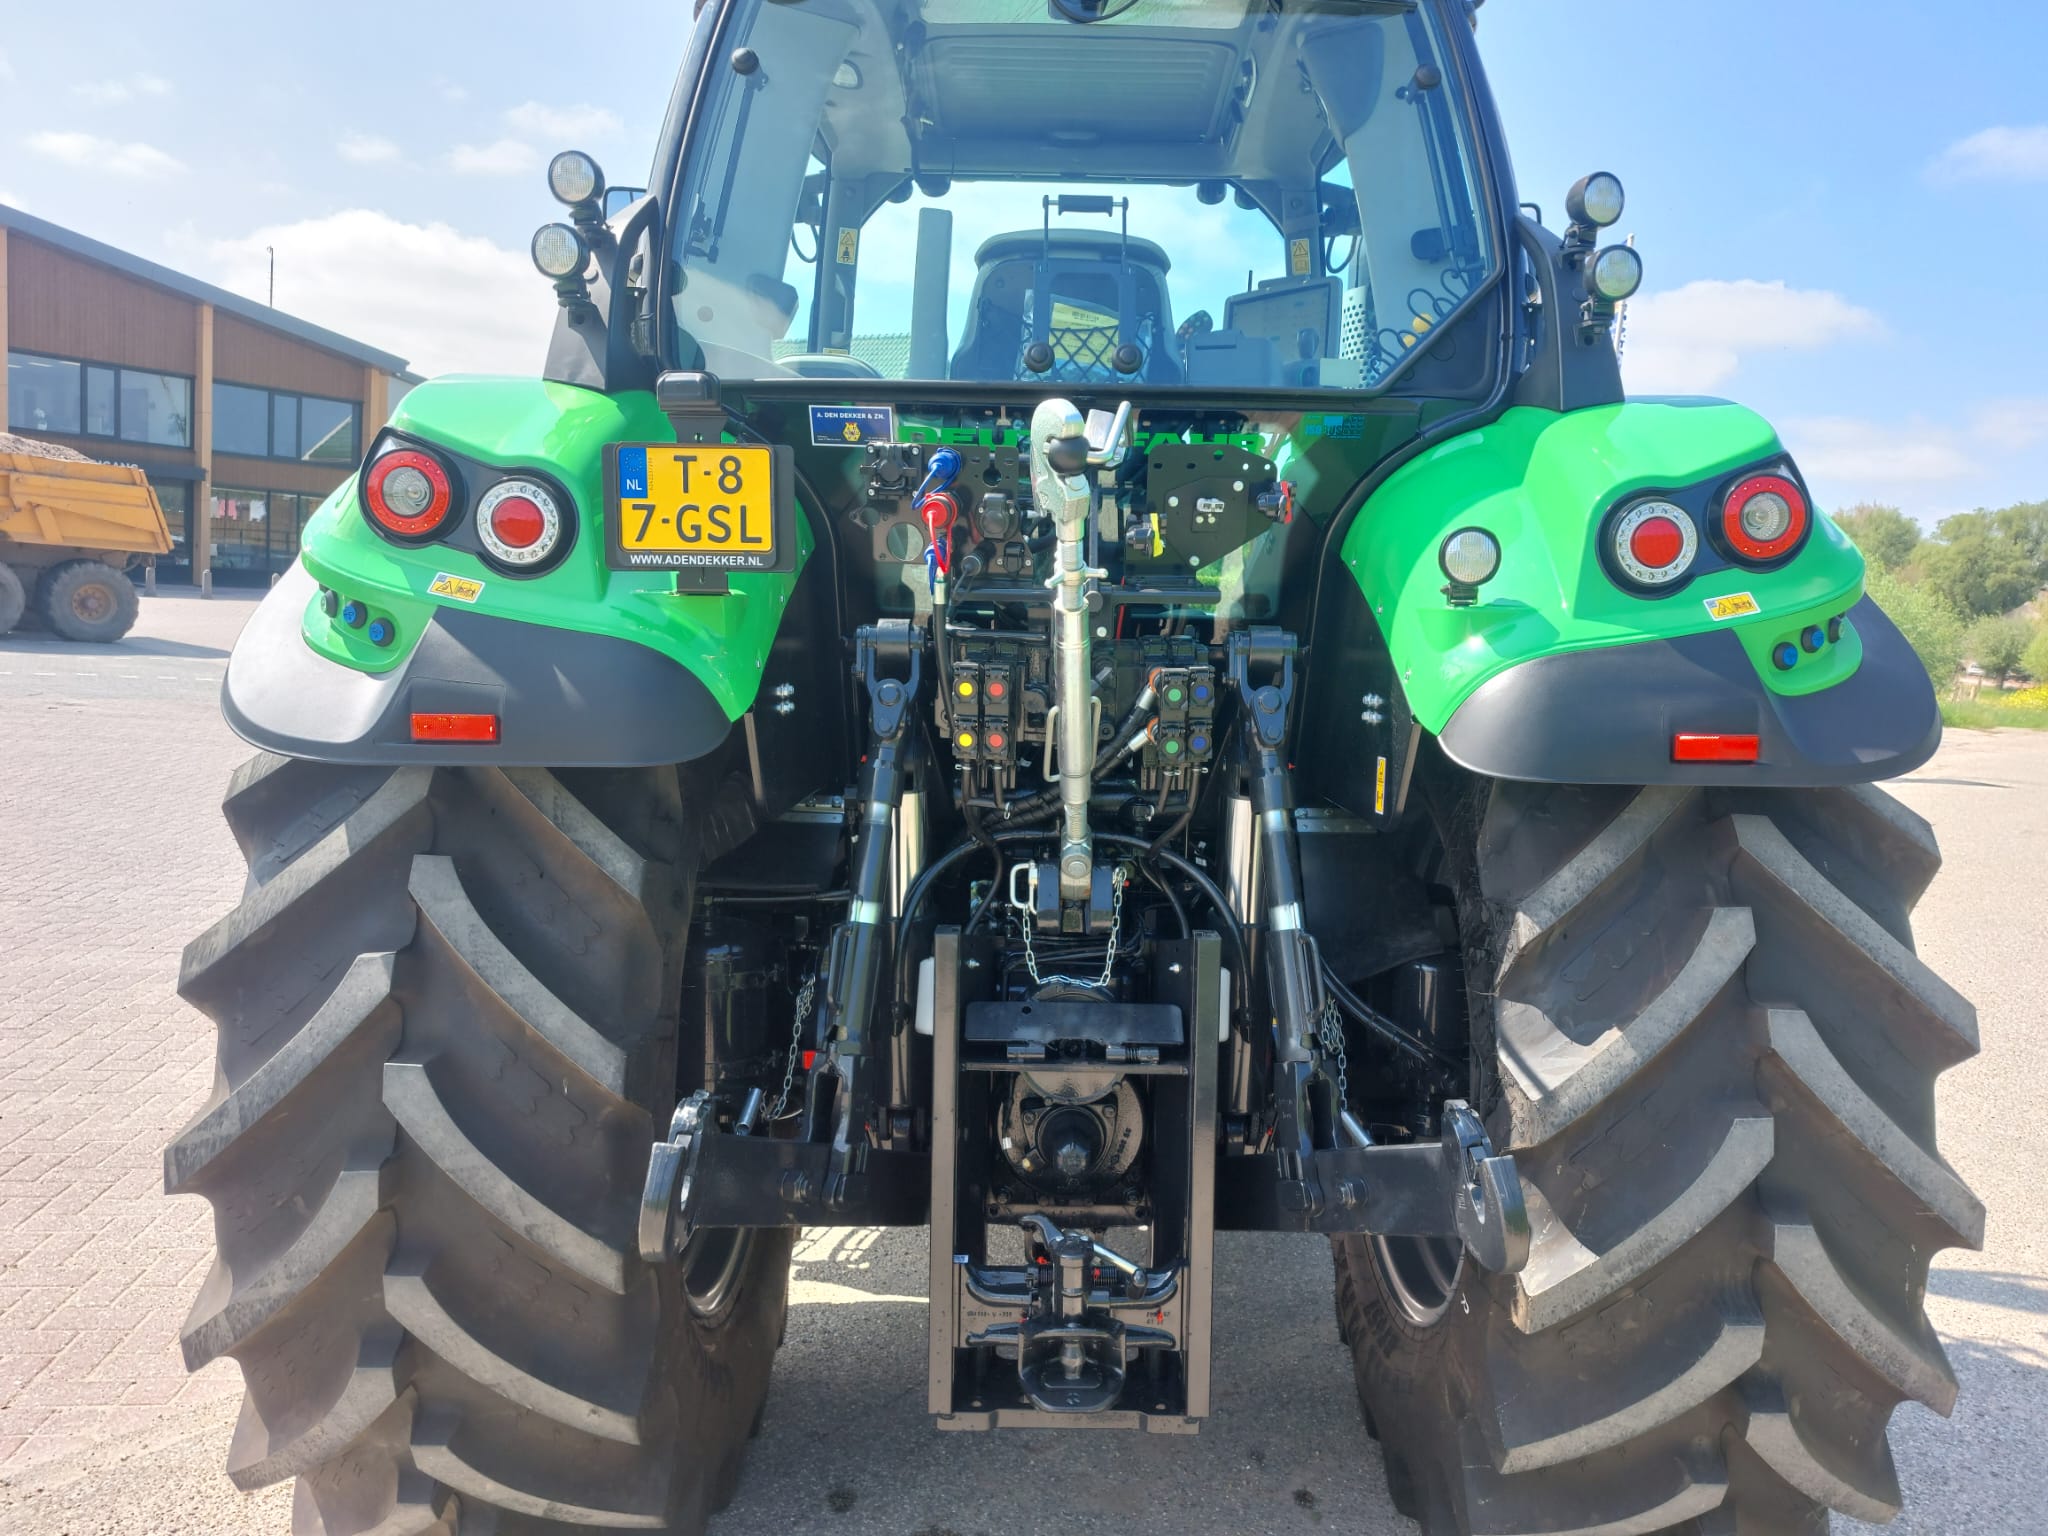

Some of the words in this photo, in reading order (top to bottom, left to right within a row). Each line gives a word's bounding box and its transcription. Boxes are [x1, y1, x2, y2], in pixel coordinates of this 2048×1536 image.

[626, 478, 643, 491] NL
[673, 455, 743, 494] T-8
[631, 503, 762, 544] 7-GSL
[630, 554, 764, 567] WWW.ADENDEKKER.NL
